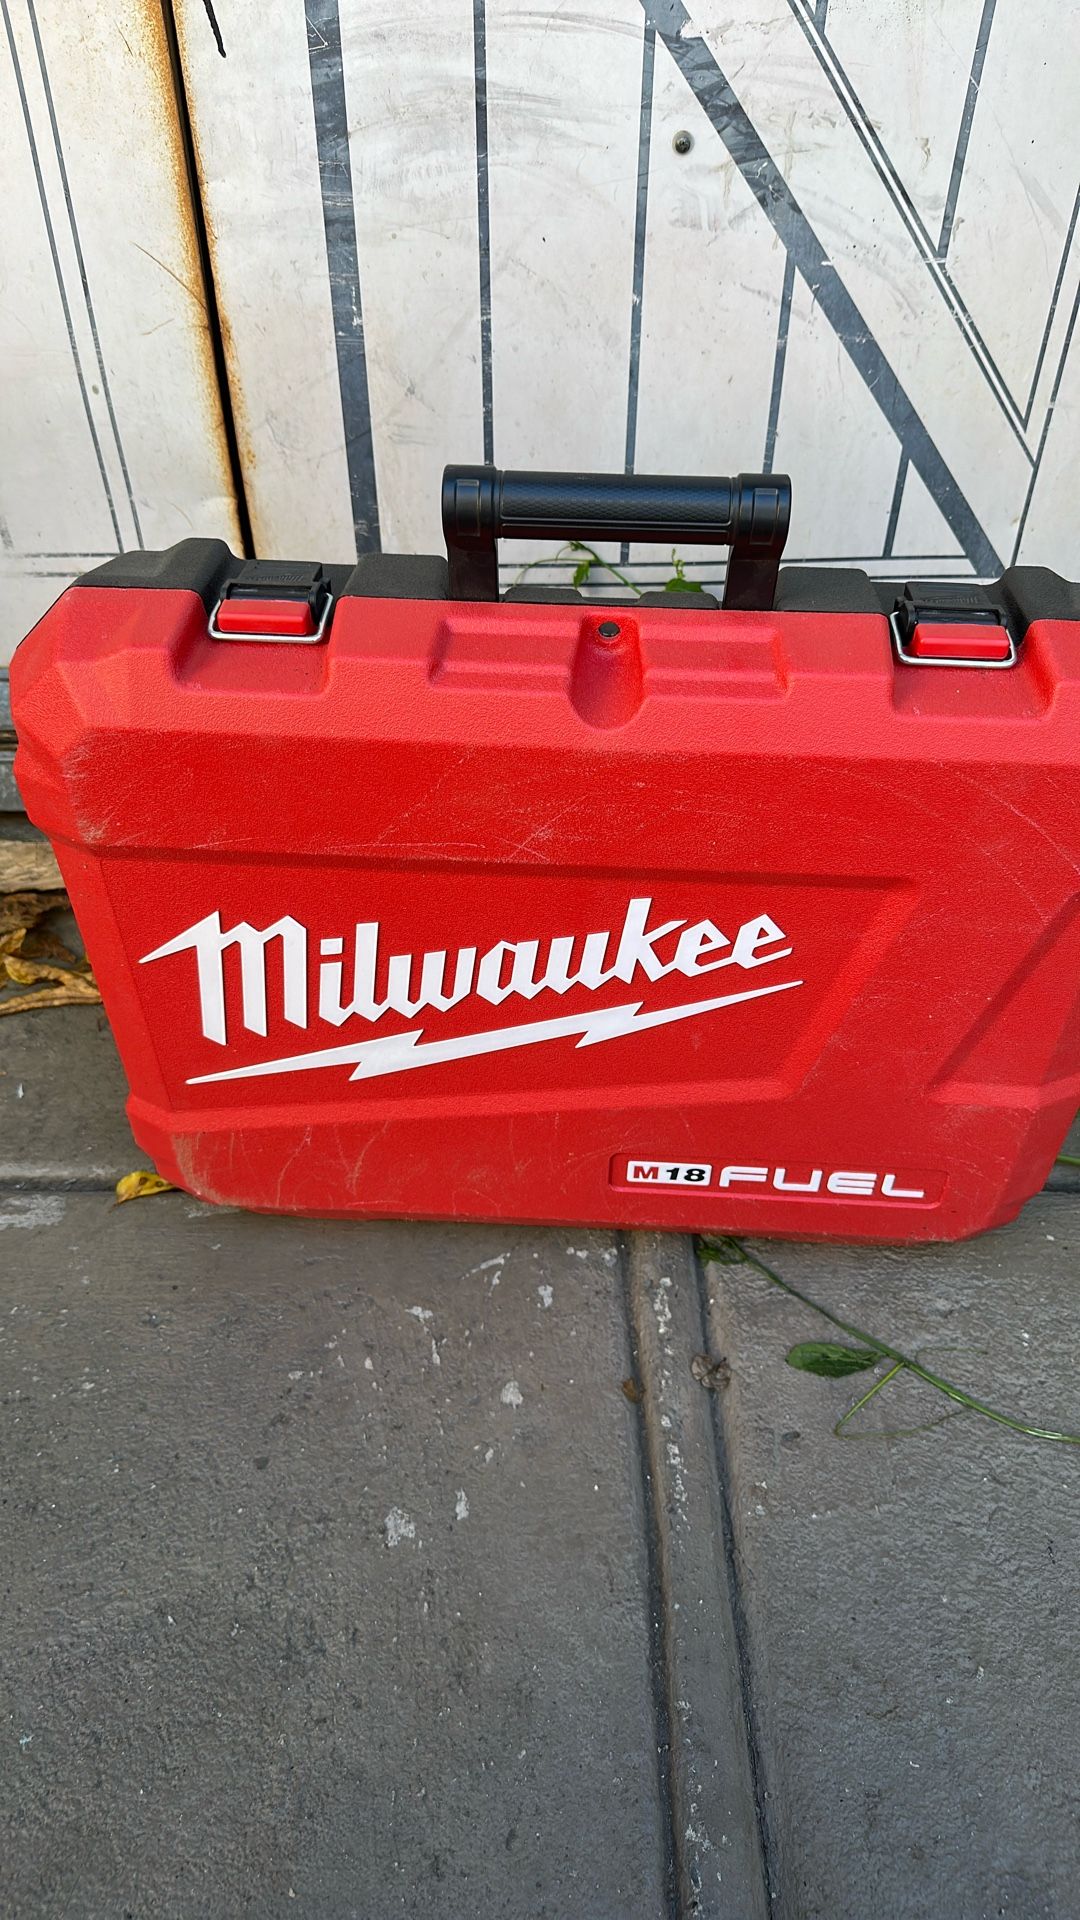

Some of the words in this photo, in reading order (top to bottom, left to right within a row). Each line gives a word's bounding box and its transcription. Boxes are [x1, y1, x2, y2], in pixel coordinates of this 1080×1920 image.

[139, 898, 792, 1045] Milwaukee
[633, 1165, 706, 1182] M18
[719, 1165, 924, 1198] FUEL
